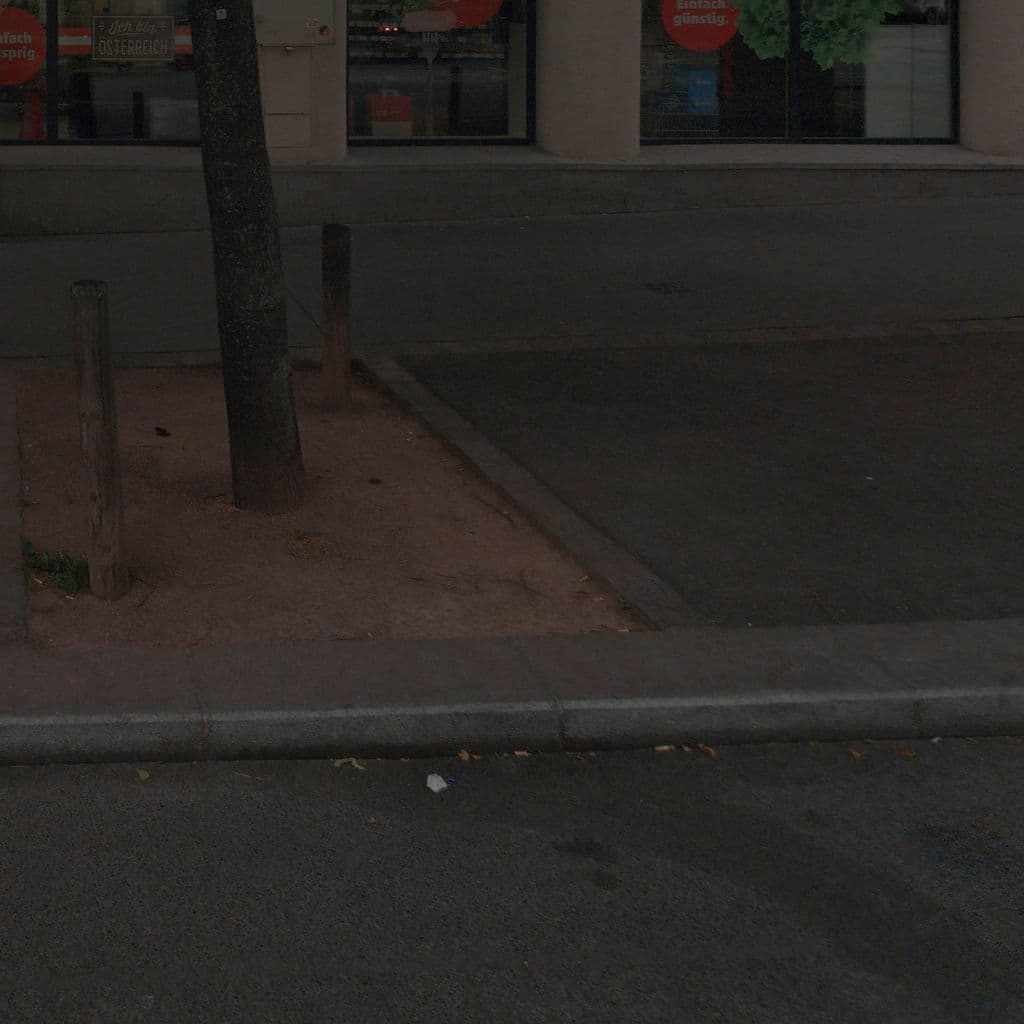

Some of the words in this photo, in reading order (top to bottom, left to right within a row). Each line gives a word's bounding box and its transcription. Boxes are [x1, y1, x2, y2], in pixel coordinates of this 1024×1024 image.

[109, 18, 134, 36] Ich
[135, 18, 156, 33] bin
[673, 12, 729, 27] günstig.
[98, 37, 169, 56] ÖSTERREICH
